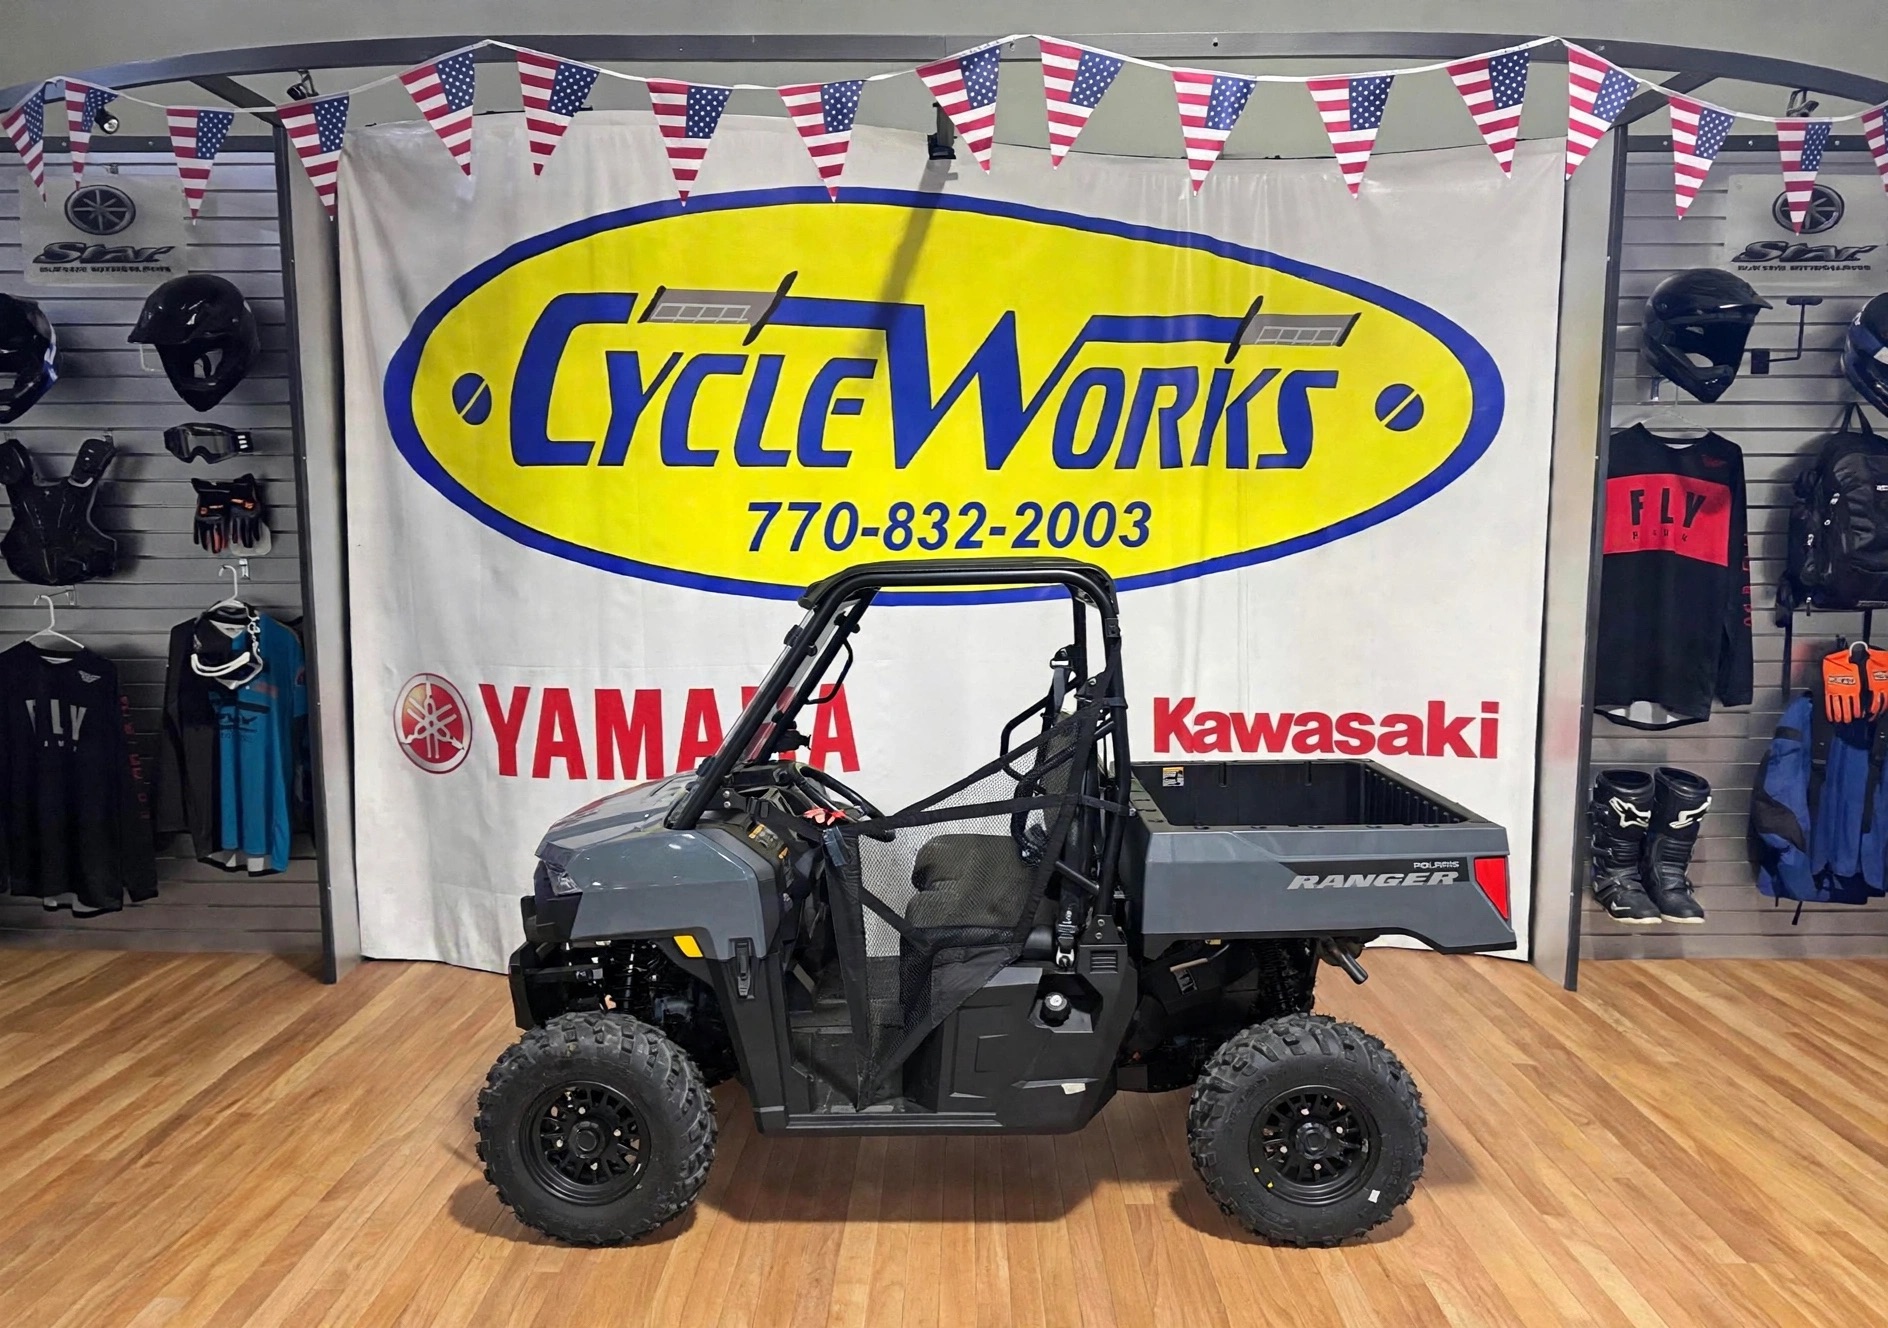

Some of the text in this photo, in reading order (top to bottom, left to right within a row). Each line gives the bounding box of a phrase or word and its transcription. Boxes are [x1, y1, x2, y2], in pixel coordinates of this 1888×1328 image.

[747, 501, 1151, 552] 770-832-2003
[1630, 488, 1707, 528] FLY
[1153, 697, 1499, 759] Kawasaki
[1287, 871, 1459, 890] RANGER
